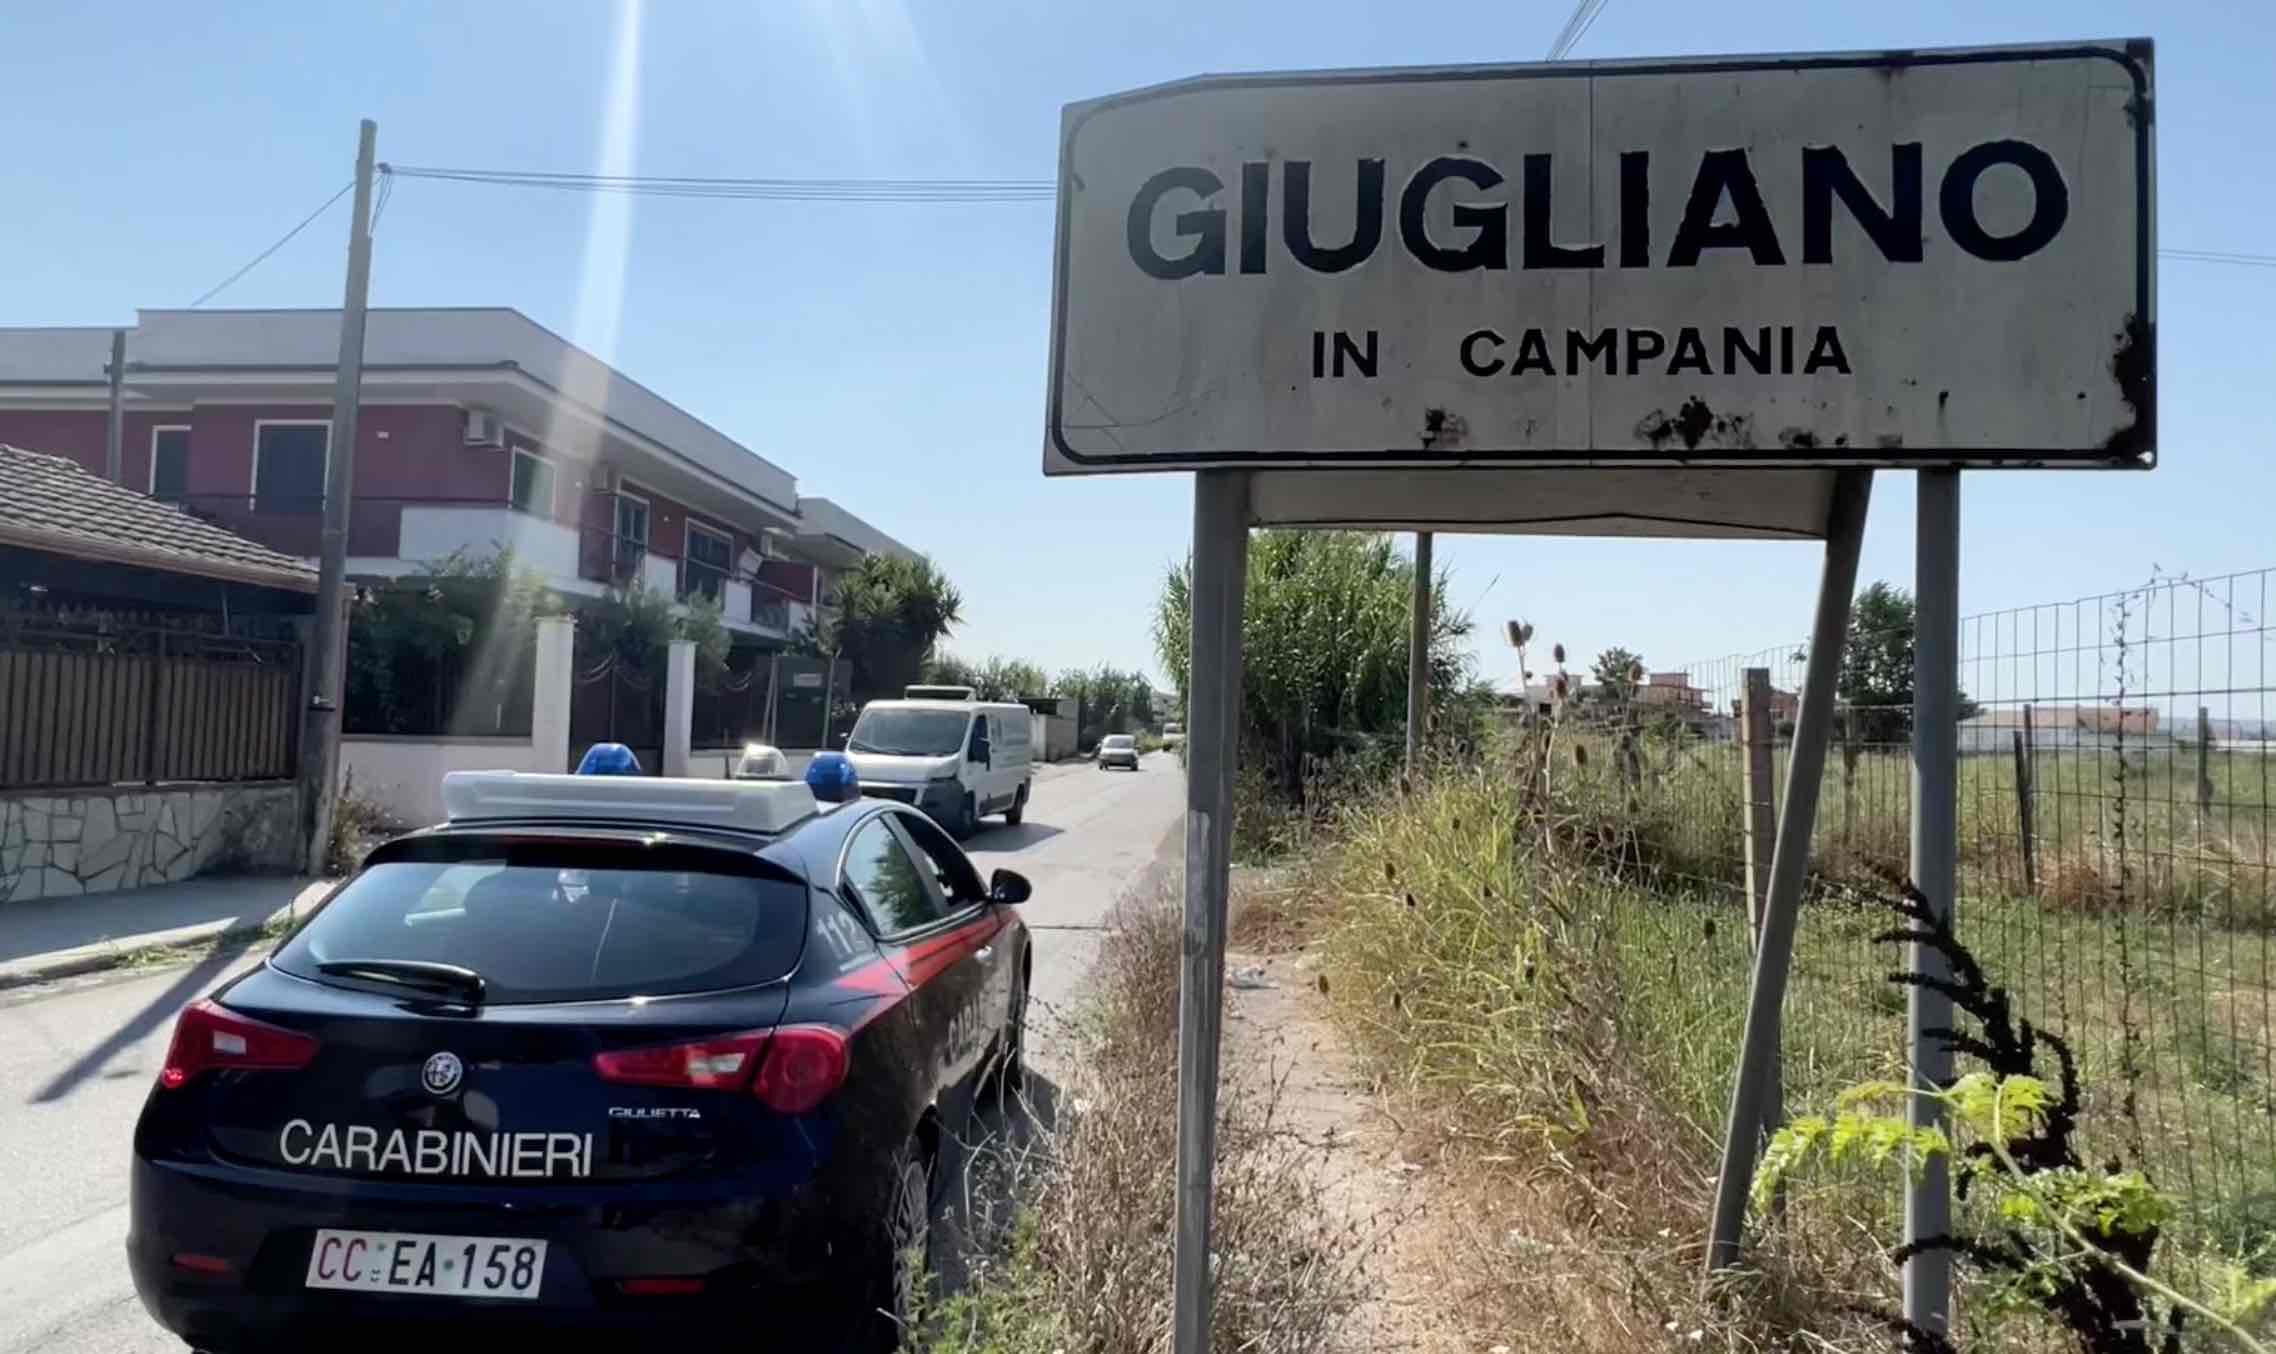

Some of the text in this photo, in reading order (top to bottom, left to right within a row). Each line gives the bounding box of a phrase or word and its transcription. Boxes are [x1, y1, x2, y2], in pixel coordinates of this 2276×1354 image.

[1126, 138, 2069, 281] GIUGLIANO
[1312, 326, 1852, 379] IN CAMPANIA
[608, 1106, 701, 1119] GIULIETTA
[279, 1119, 594, 1178] CARABINIERI
[318, 1237, 537, 1291] CC EA 158
